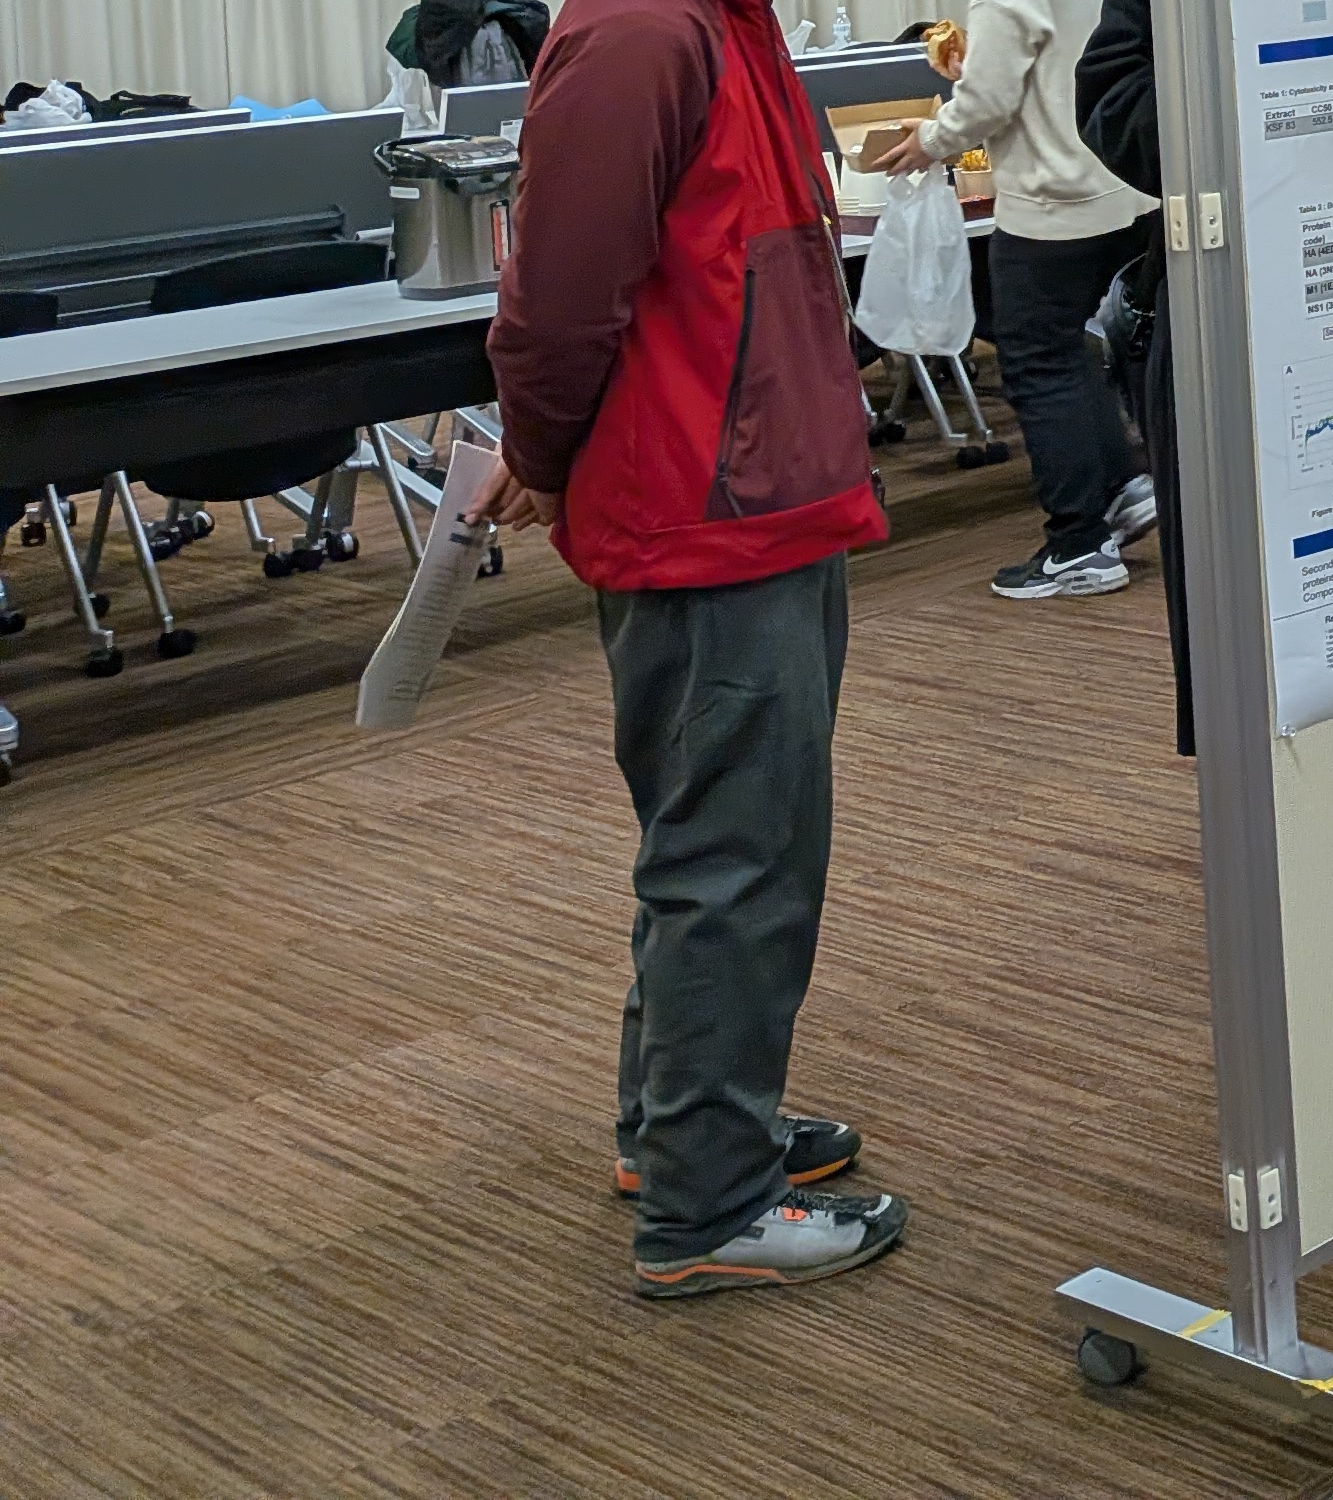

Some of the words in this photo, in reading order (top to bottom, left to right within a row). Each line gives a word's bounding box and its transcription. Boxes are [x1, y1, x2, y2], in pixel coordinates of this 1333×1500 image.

[1266, 110, 1295, 120] Extract
[1311, 104, 1331, 113] CC50
[1266, 123, 1283, 132] KSF
